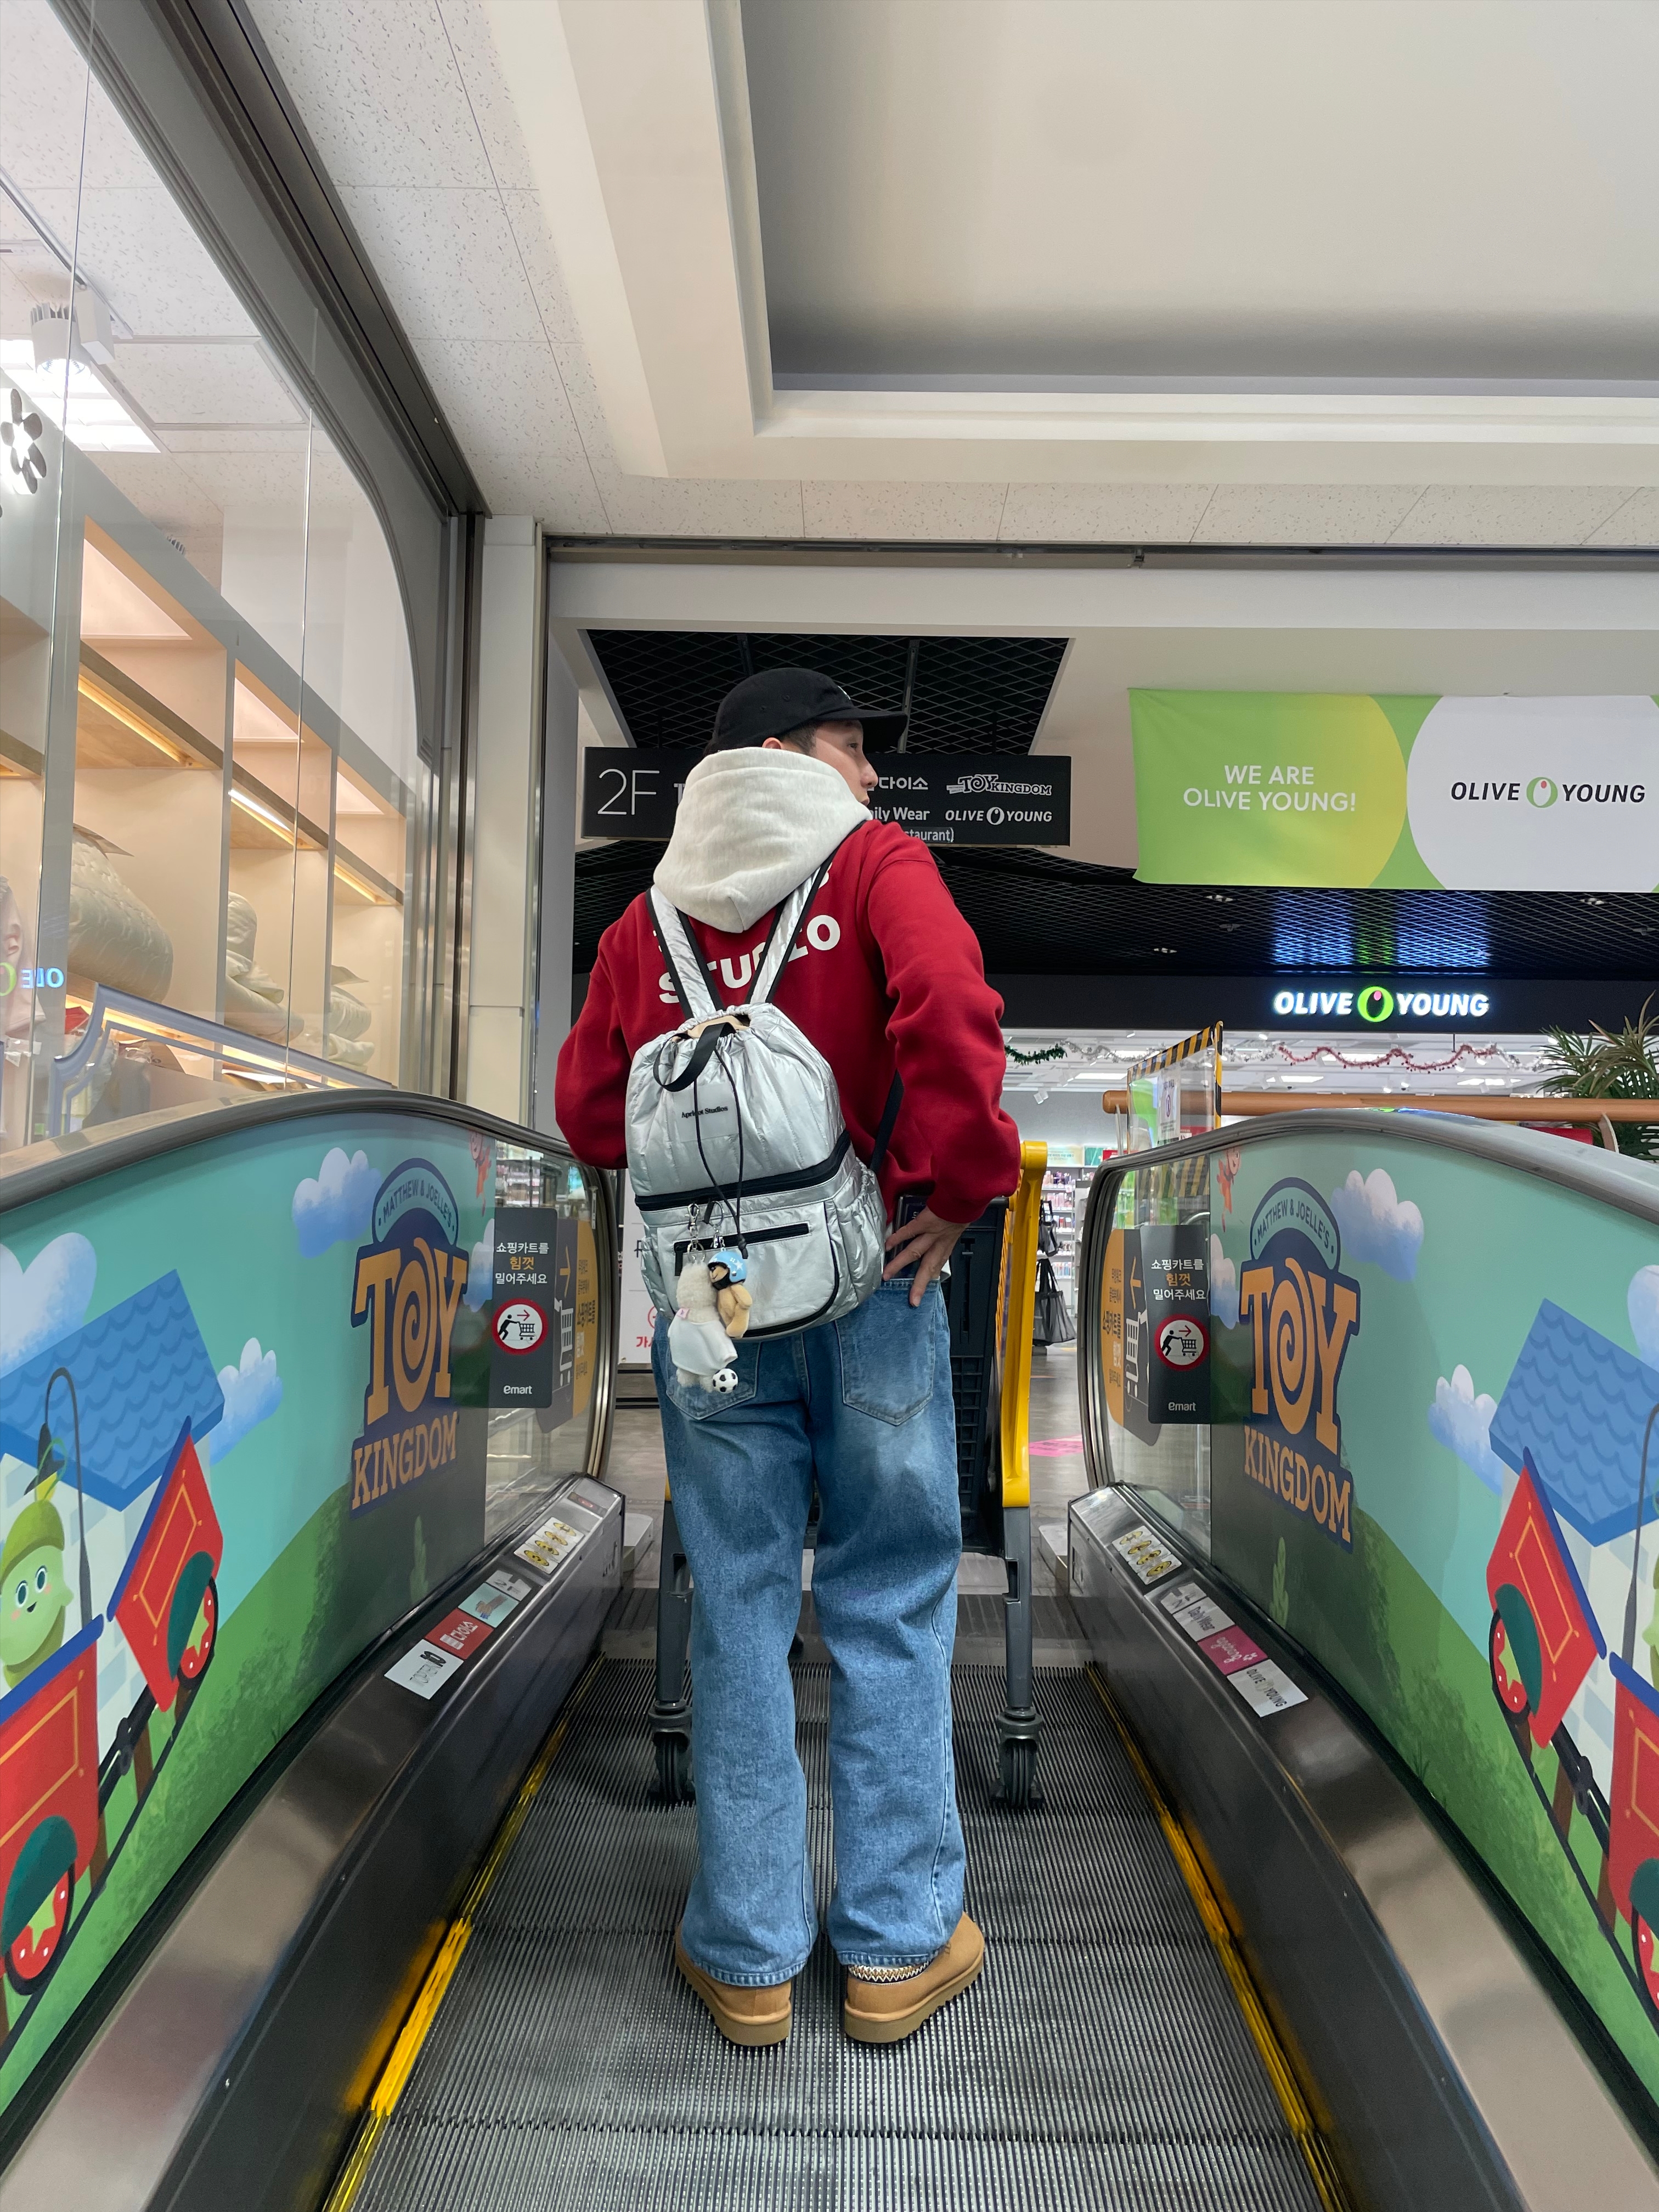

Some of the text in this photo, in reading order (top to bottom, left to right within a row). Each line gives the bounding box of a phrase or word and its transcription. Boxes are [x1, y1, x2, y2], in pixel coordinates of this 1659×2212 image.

[879, 777, 928, 790] 다이소
[1224, 765, 1314, 785] WE ARE
[597, 769, 659, 815] 2F
[959, 775, 998, 792] TOY
[991, 782, 1051, 795] KINGDOM
[1451, 782, 1645, 803] OLIVE YOUNG
[1183, 788, 1356, 812] OLIVE YOUNG!
[872, 806, 930, 822] ily Wear
[945, 810, 1052, 822] OLIVE YOUNG
[1273, 991, 1489, 1017] OLIVE YOUNG
[681, 1110, 704, 1118] Apriot
[383, 1179, 452, 1227] MATTHEW & JOELLE'S
[1257, 1199, 1329, 1249] MATTHEW & JOELLE'S
[496, 1242, 549, 1254] 쇼핑카트를
[510, 1256, 534, 1270] 힘껏
[1151, 1259, 1204, 1271] 쇼핑카트를
[495, 1272, 548, 1285] 밀어주세요
[1166, 1273, 1191, 1286] 힘껏
[1153, 1289, 1206, 1301] 밀어주세요
[354, 1237, 467, 1425] TOY
[1241, 1257, 1357, 1455] TOY
[503, 1384, 533, 1395] emart
[1168, 1401, 1197, 1412] emart
[352, 1413, 458, 1510] KINGDOM
[1243, 1425, 1352, 1544] KINGDOM
[1264, 1688, 1287, 1707] YOUNG
